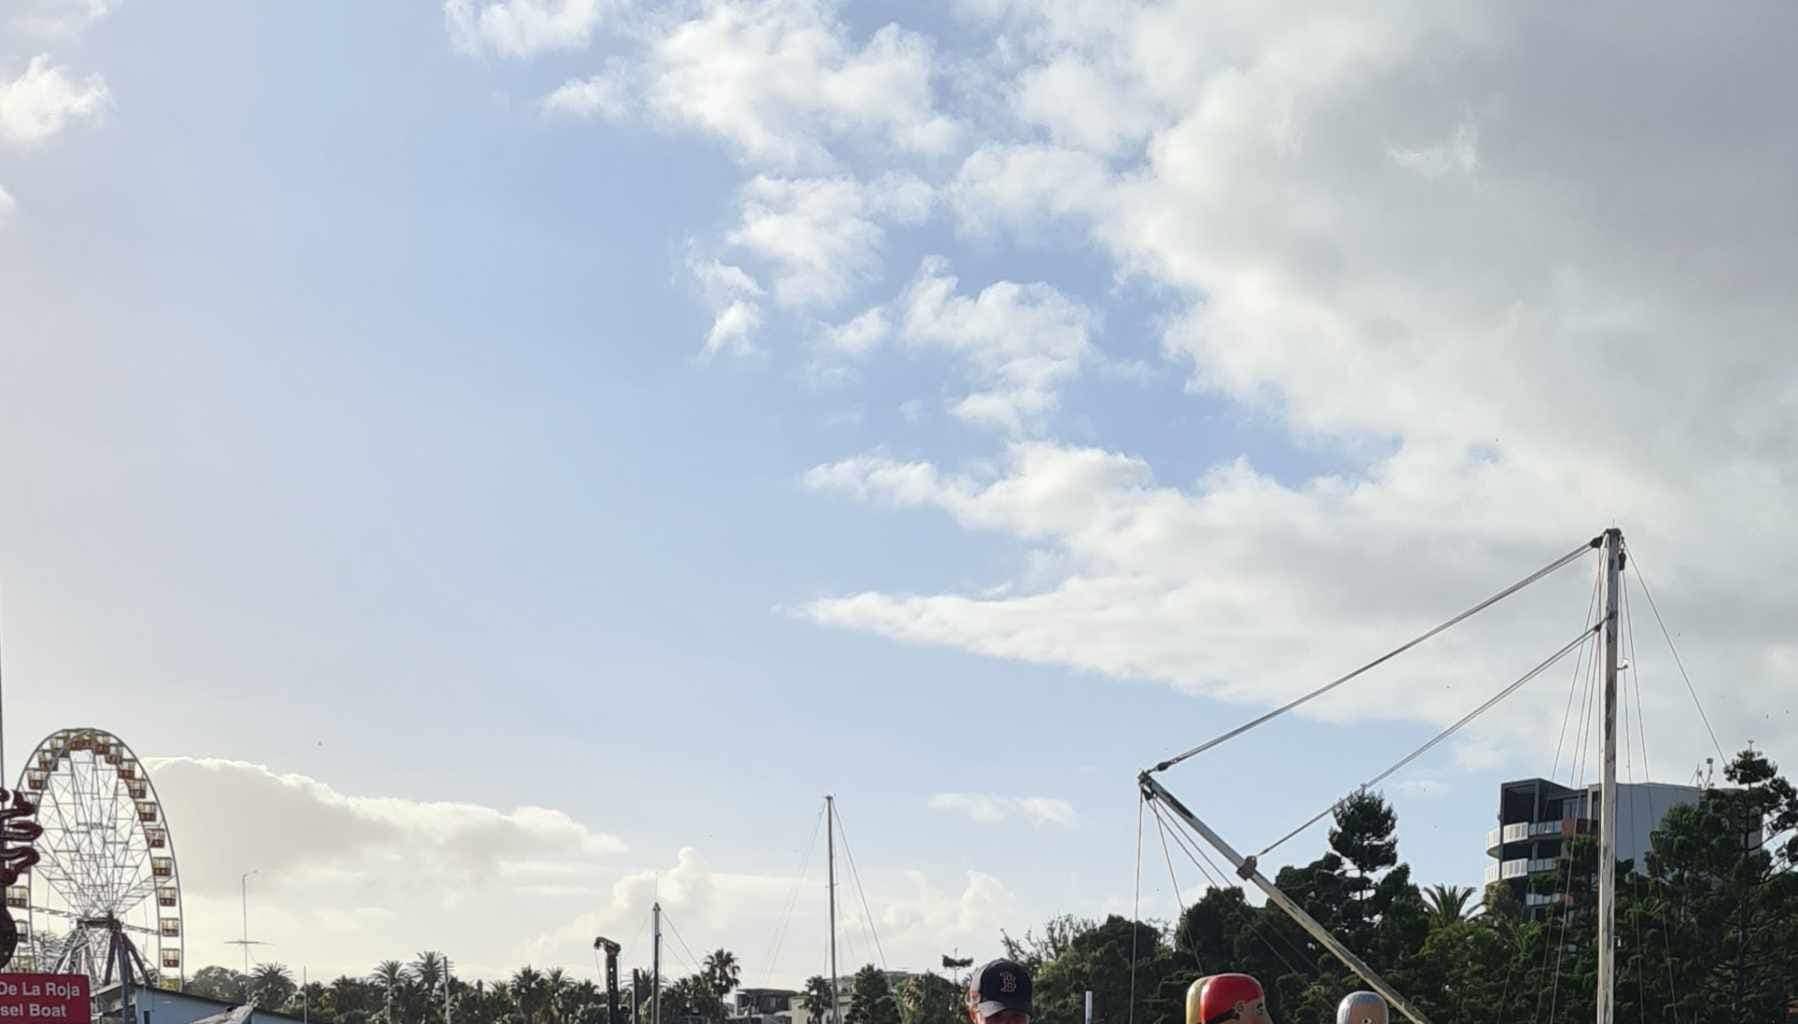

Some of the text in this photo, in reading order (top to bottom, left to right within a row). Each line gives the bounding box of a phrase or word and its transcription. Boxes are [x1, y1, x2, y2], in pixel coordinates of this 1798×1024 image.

[0, 982, 80, 1000] De La Roja
[29, 1003, 67, 1017] Boat
